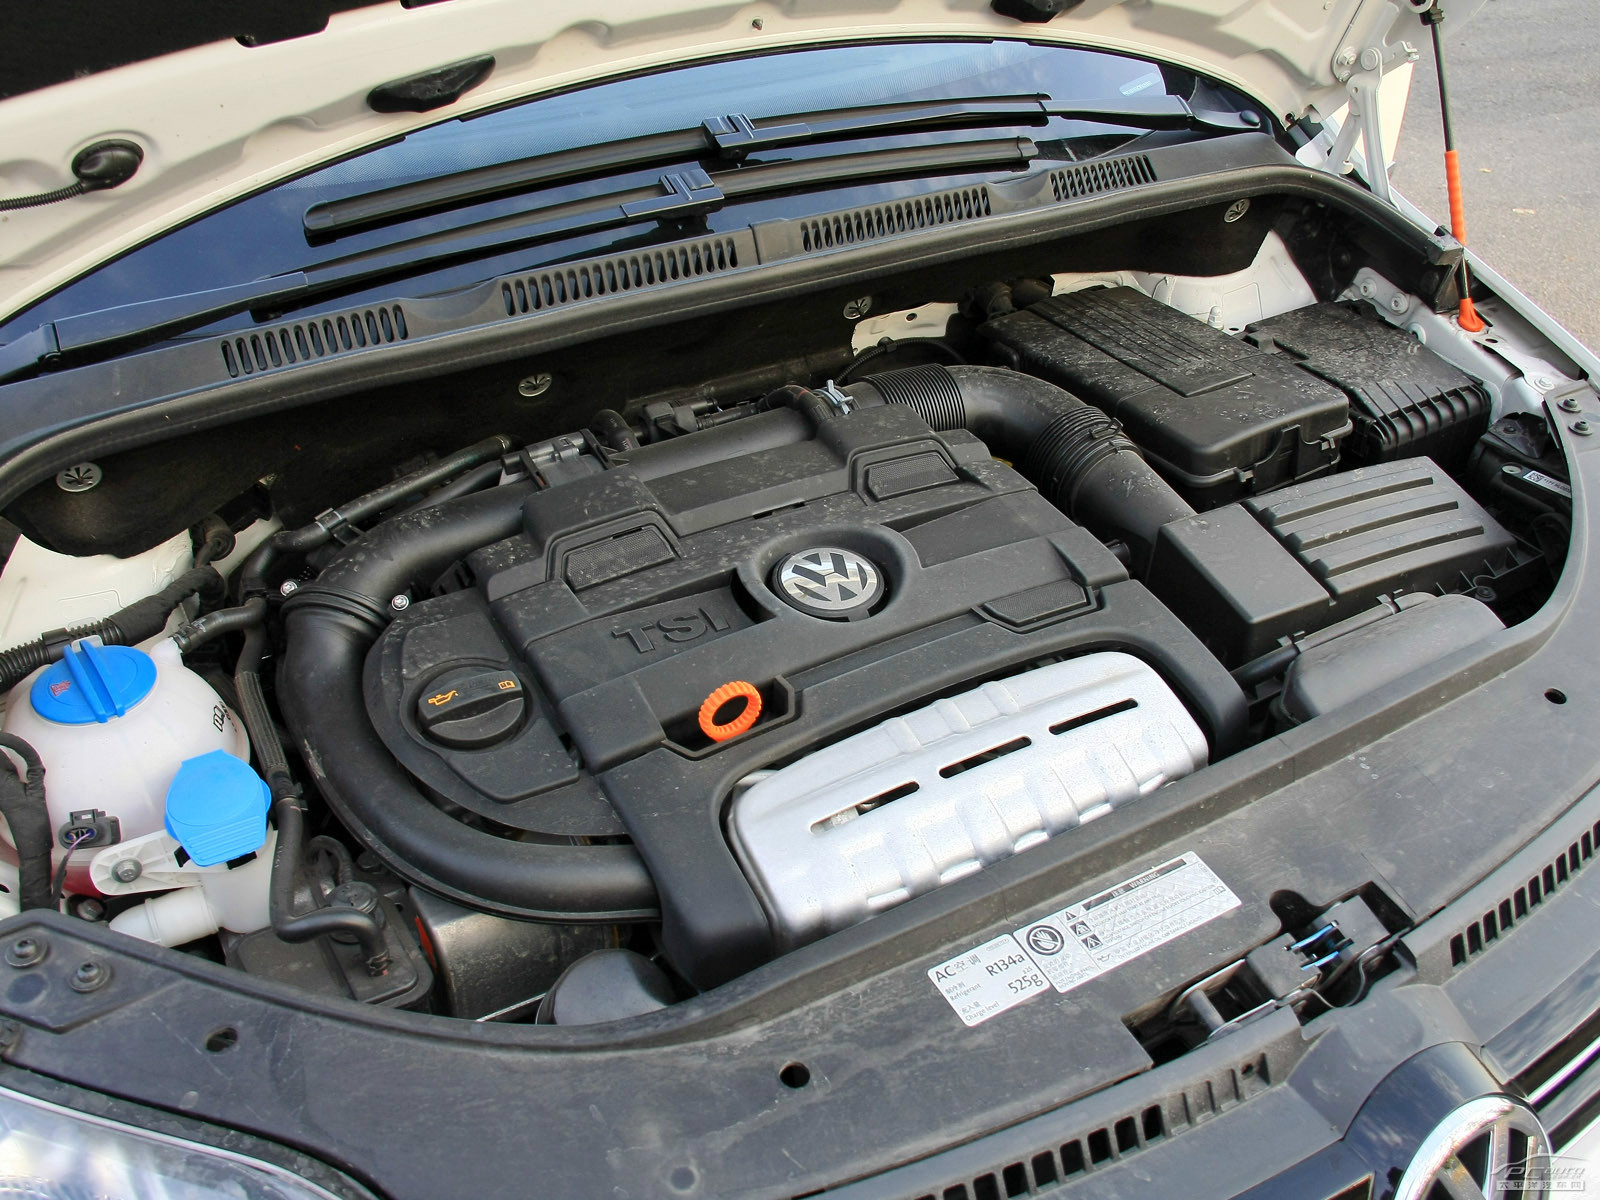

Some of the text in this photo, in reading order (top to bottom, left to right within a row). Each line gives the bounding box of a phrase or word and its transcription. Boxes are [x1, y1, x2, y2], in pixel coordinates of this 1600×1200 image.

[611, 607, 730, 653] TSI
[1128, 871, 1160, 889] WARNING
[985, 953, 1026, 977] R134a
[949, 983, 982, 1001] Refrigerant
[1007, 973, 1044, 994] 525g
[965, 1000, 1000, 1021] Charge level
